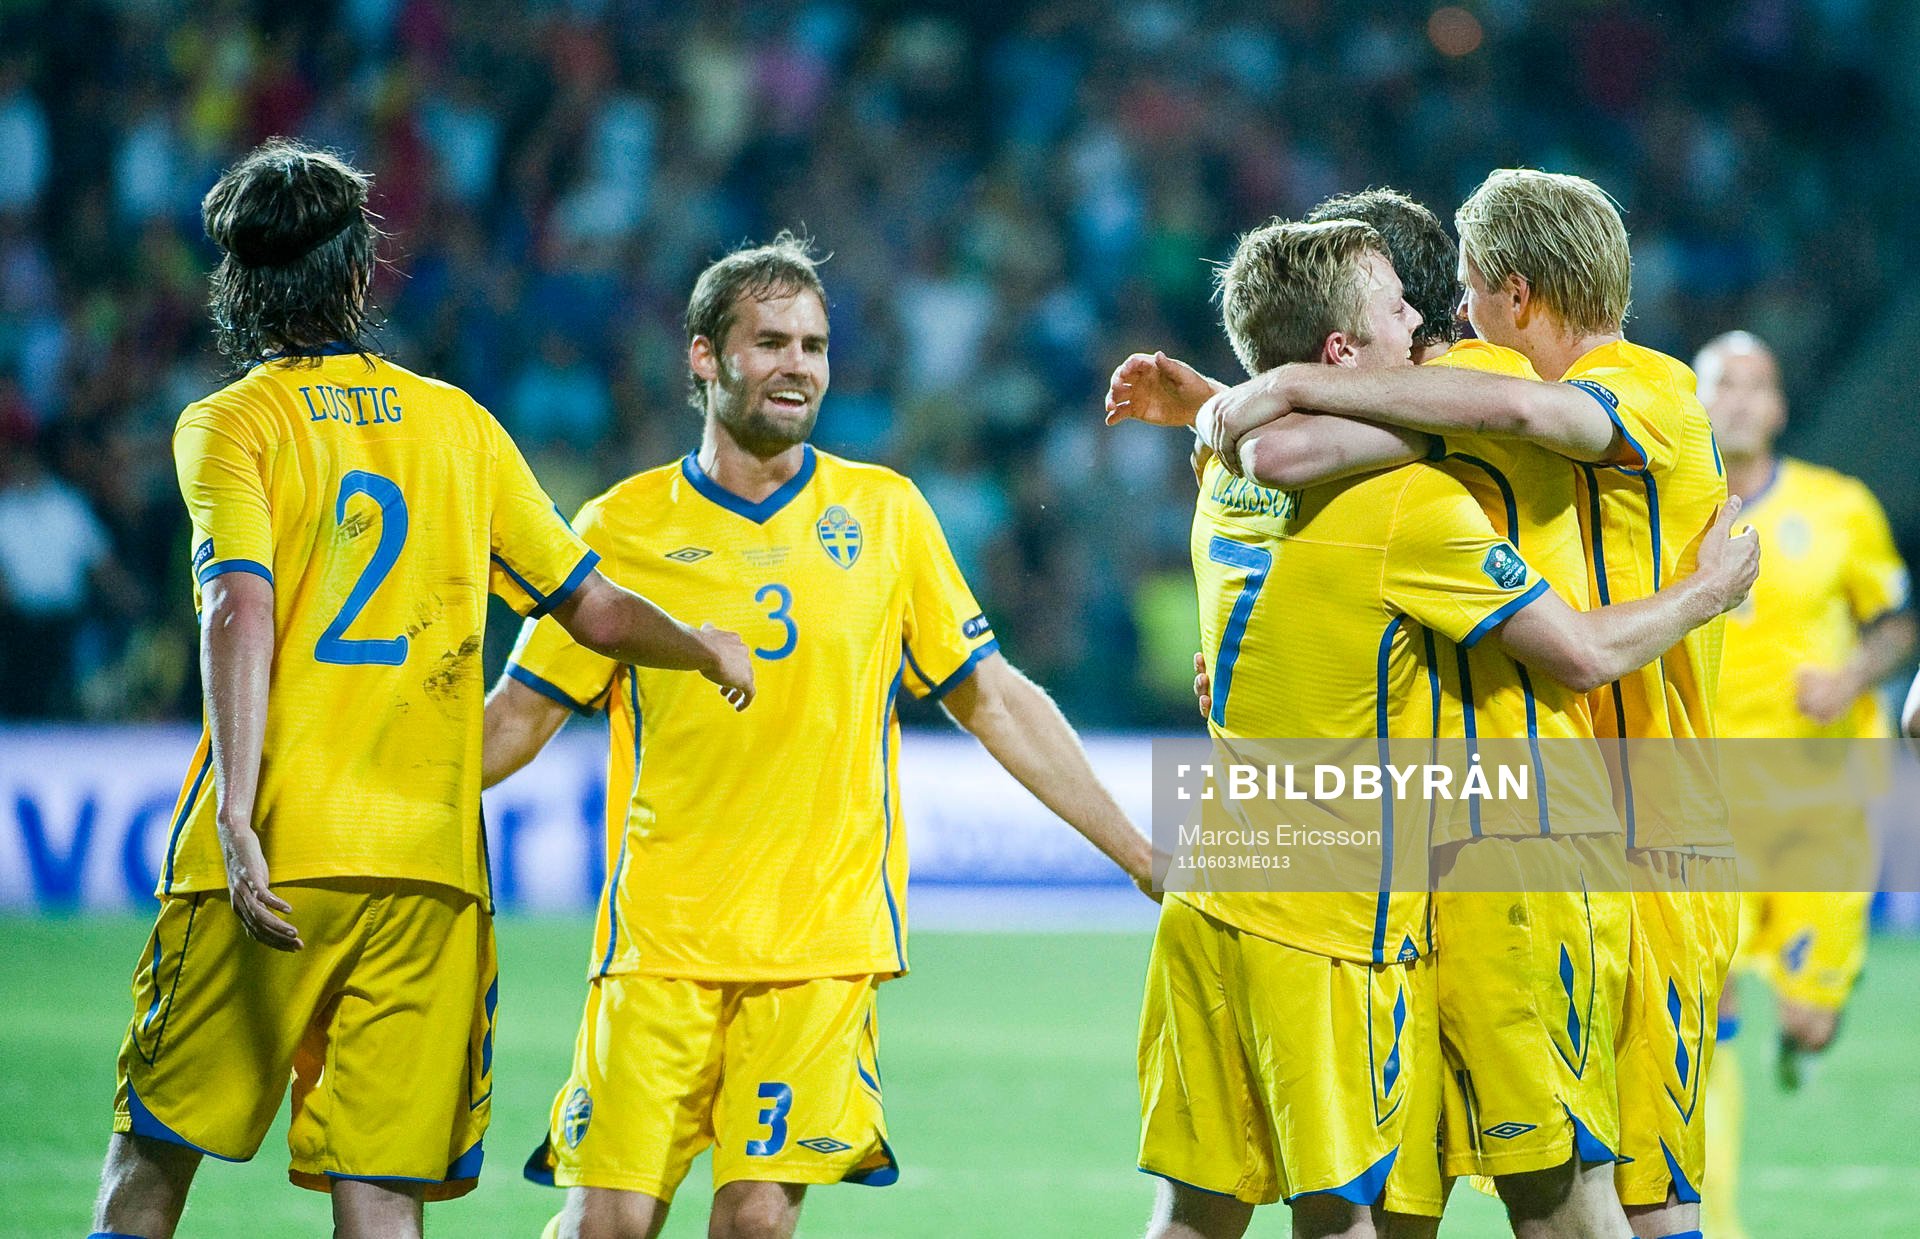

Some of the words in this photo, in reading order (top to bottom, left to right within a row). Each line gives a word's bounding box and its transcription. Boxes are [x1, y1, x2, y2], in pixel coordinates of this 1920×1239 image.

[299, 385, 402, 426] LUSTIG
[1211, 468, 1305, 520] LARSSON
[314, 470, 409, 666] 2
[755, 585, 798, 661] 3
[1209, 535, 1272, 728] 7
[745, 1082, 793, 1157] 3
